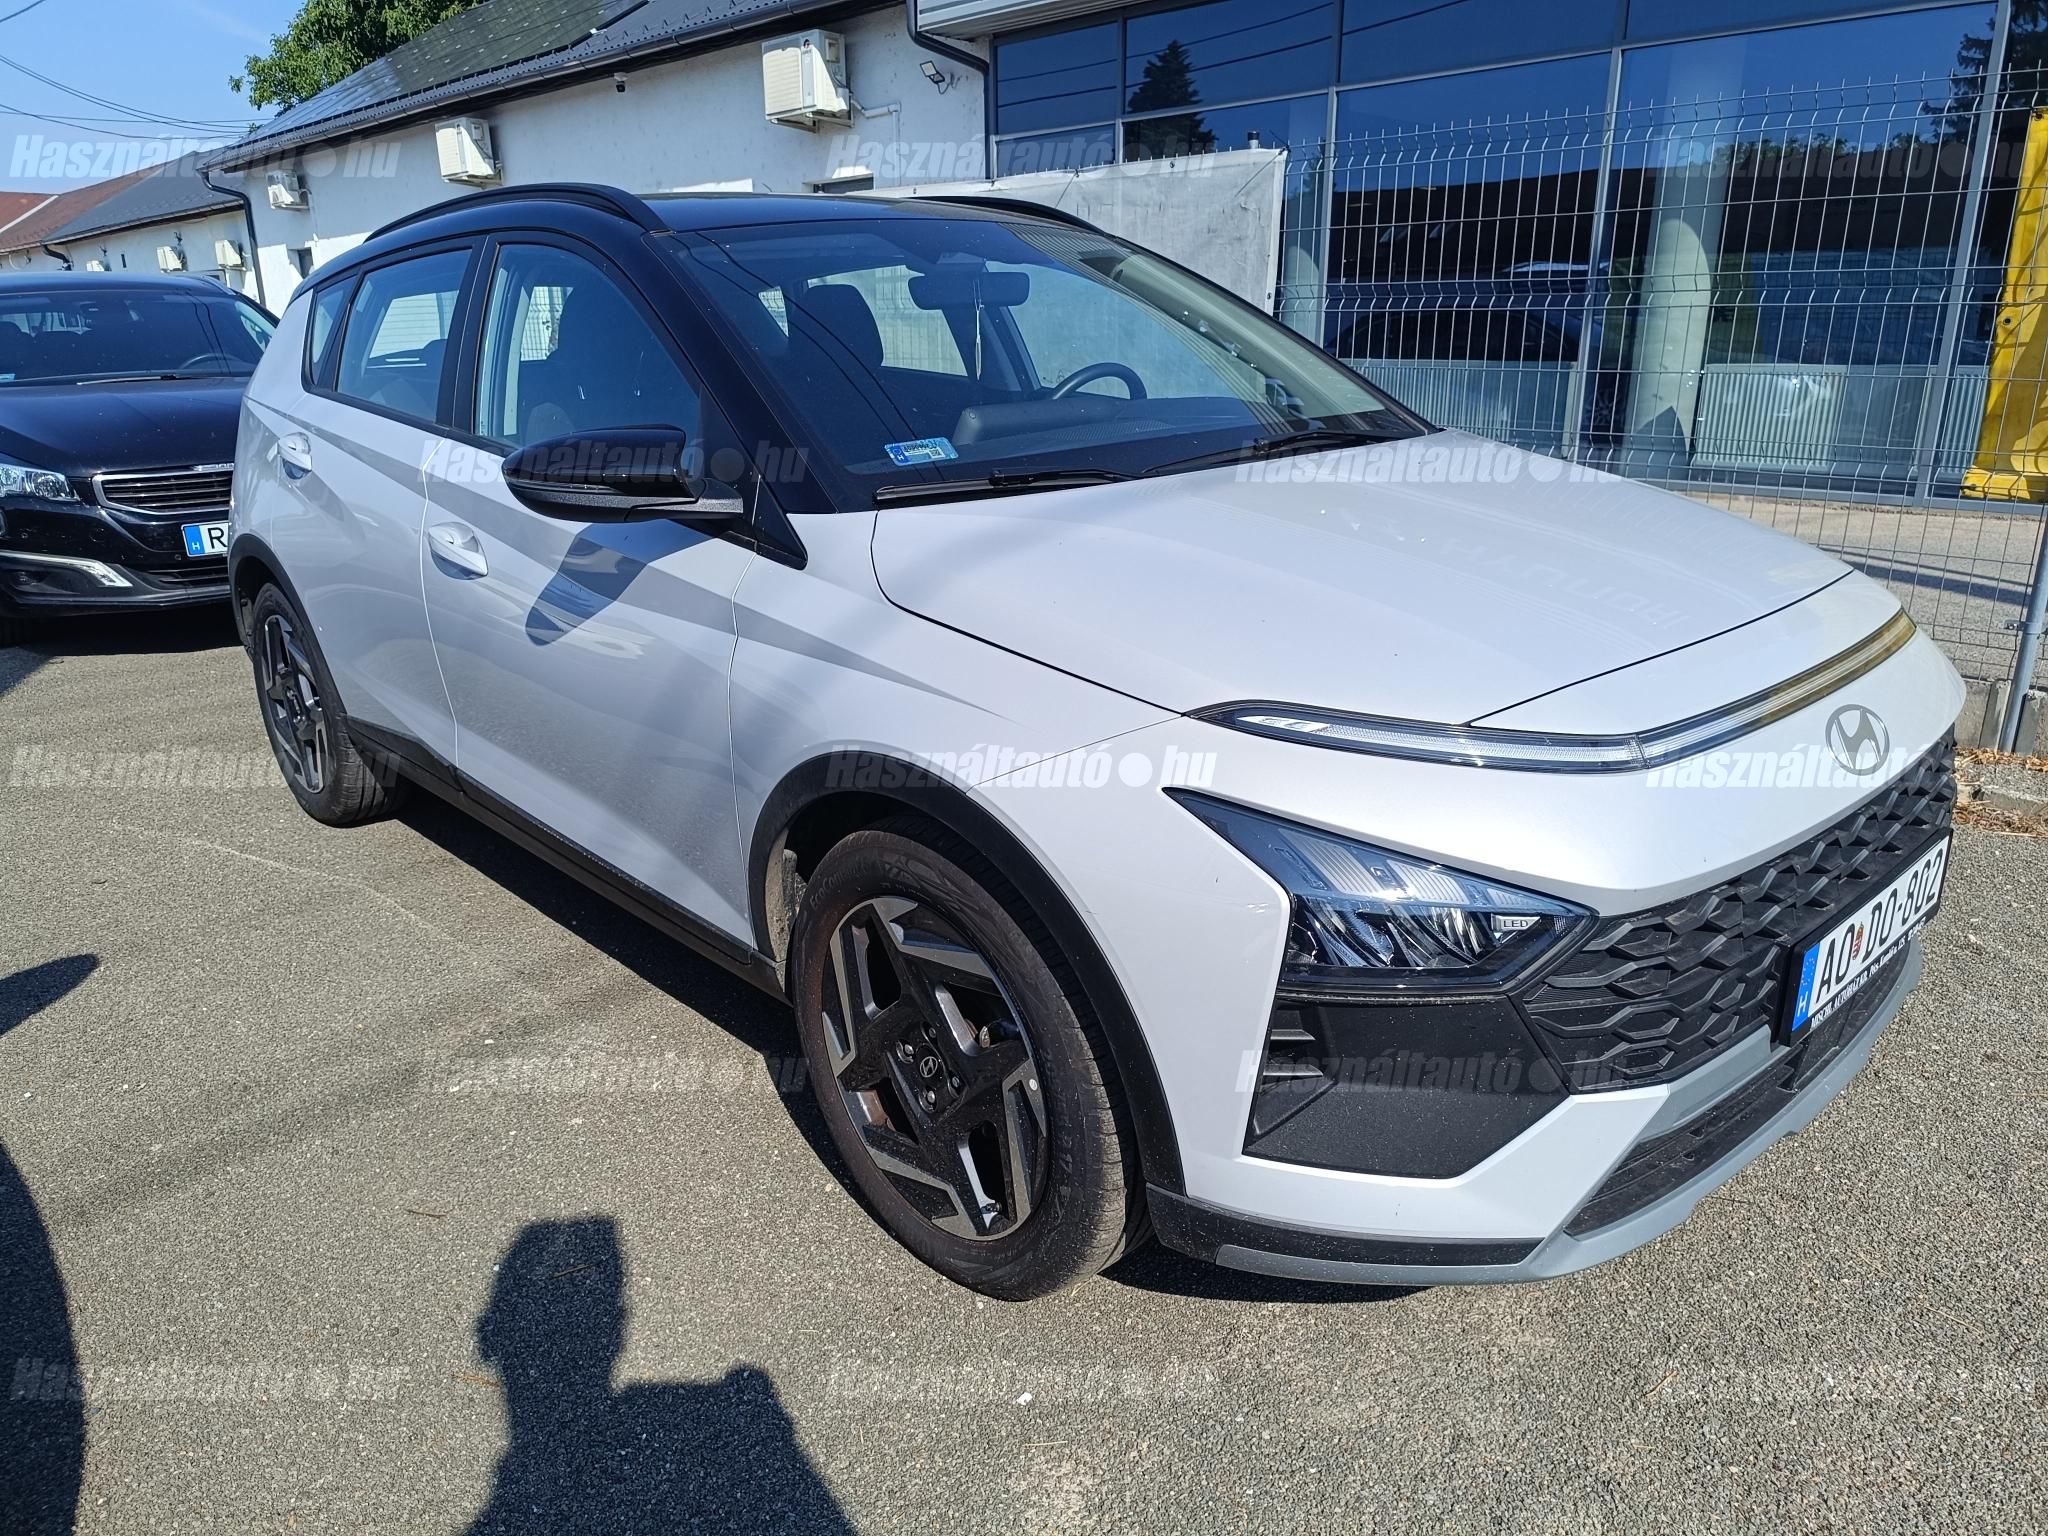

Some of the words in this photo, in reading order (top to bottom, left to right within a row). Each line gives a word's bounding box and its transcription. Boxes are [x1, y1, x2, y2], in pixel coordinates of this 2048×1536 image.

[192, 541, 200, 550] H
[1862, 848, 1944, 964] DO-802
[1503, 919, 1529, 928] LED
[1798, 991, 1808, 1016] H
